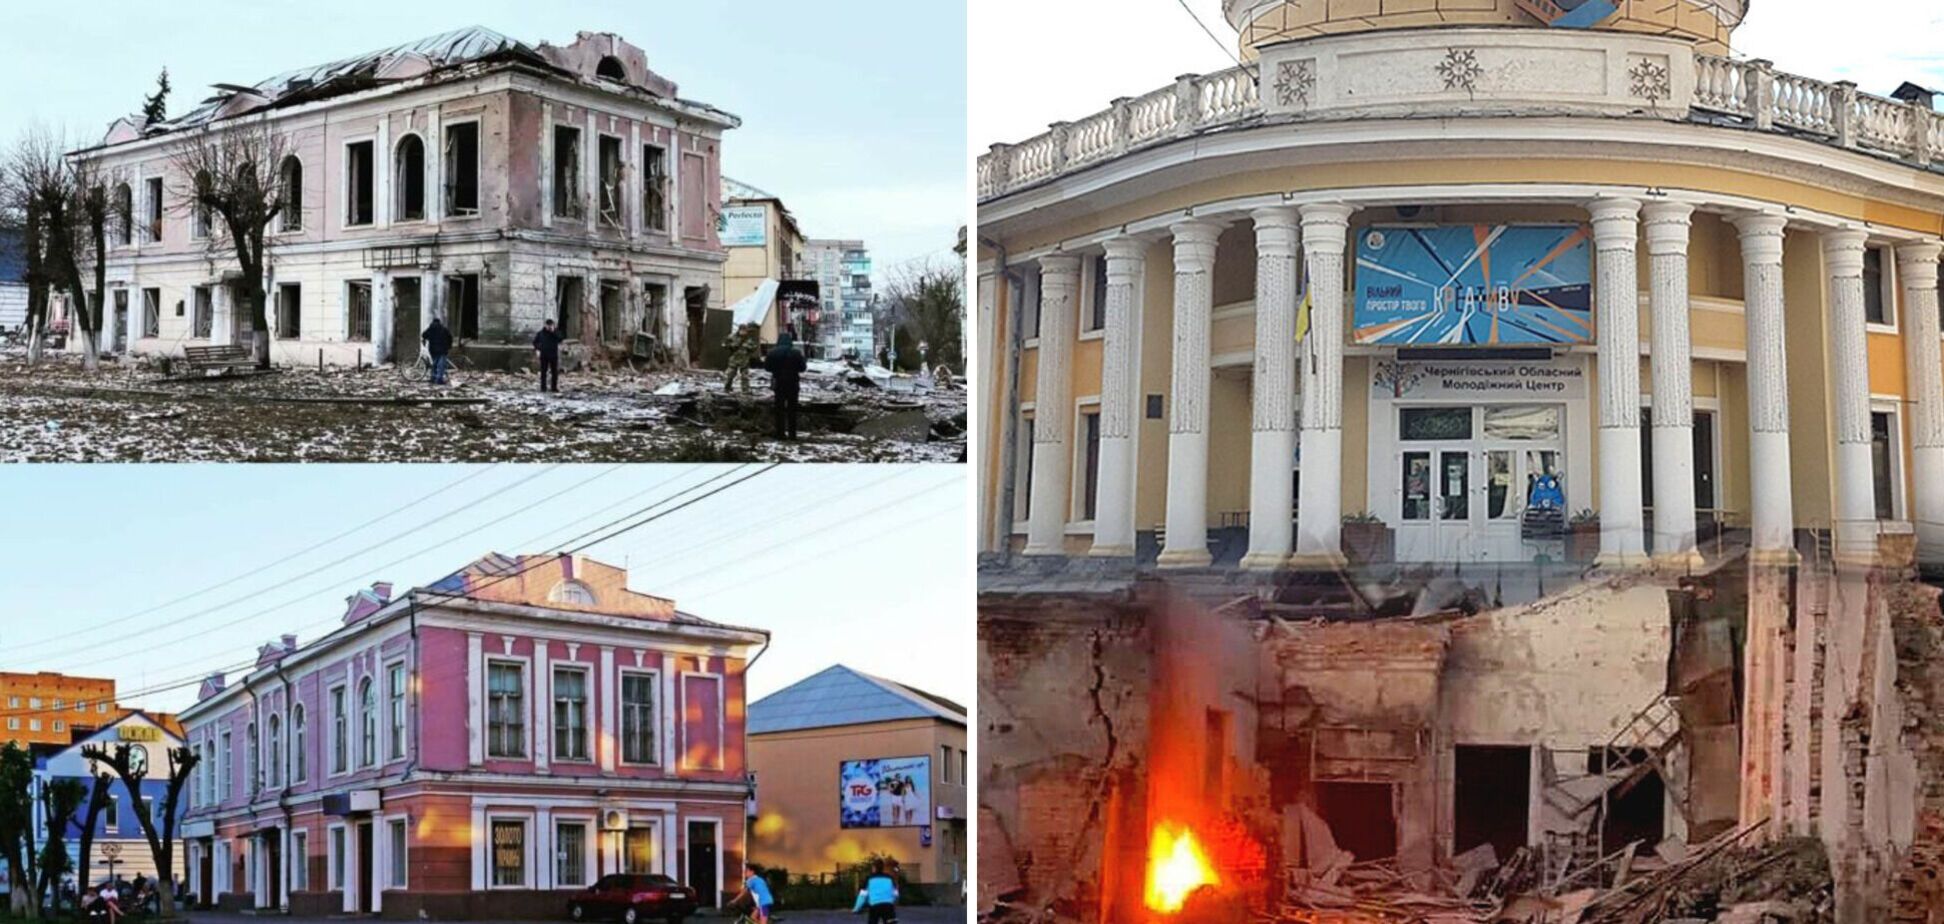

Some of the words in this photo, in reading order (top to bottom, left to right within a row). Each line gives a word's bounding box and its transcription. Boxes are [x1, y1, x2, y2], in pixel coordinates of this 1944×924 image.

[1366, 300, 1399, 312] ПРОСТІР
[1401, 300, 1427, 312] ТВОГО
[1433, 286, 1520, 314] КРЕАТИВУ
[1425, 366, 1516, 378] Чернігівський
[1519, 366, 1582, 377] Обласний
[1442, 379, 1522, 391] Молодіжний
[1526, 380, 1565, 391] Центр
